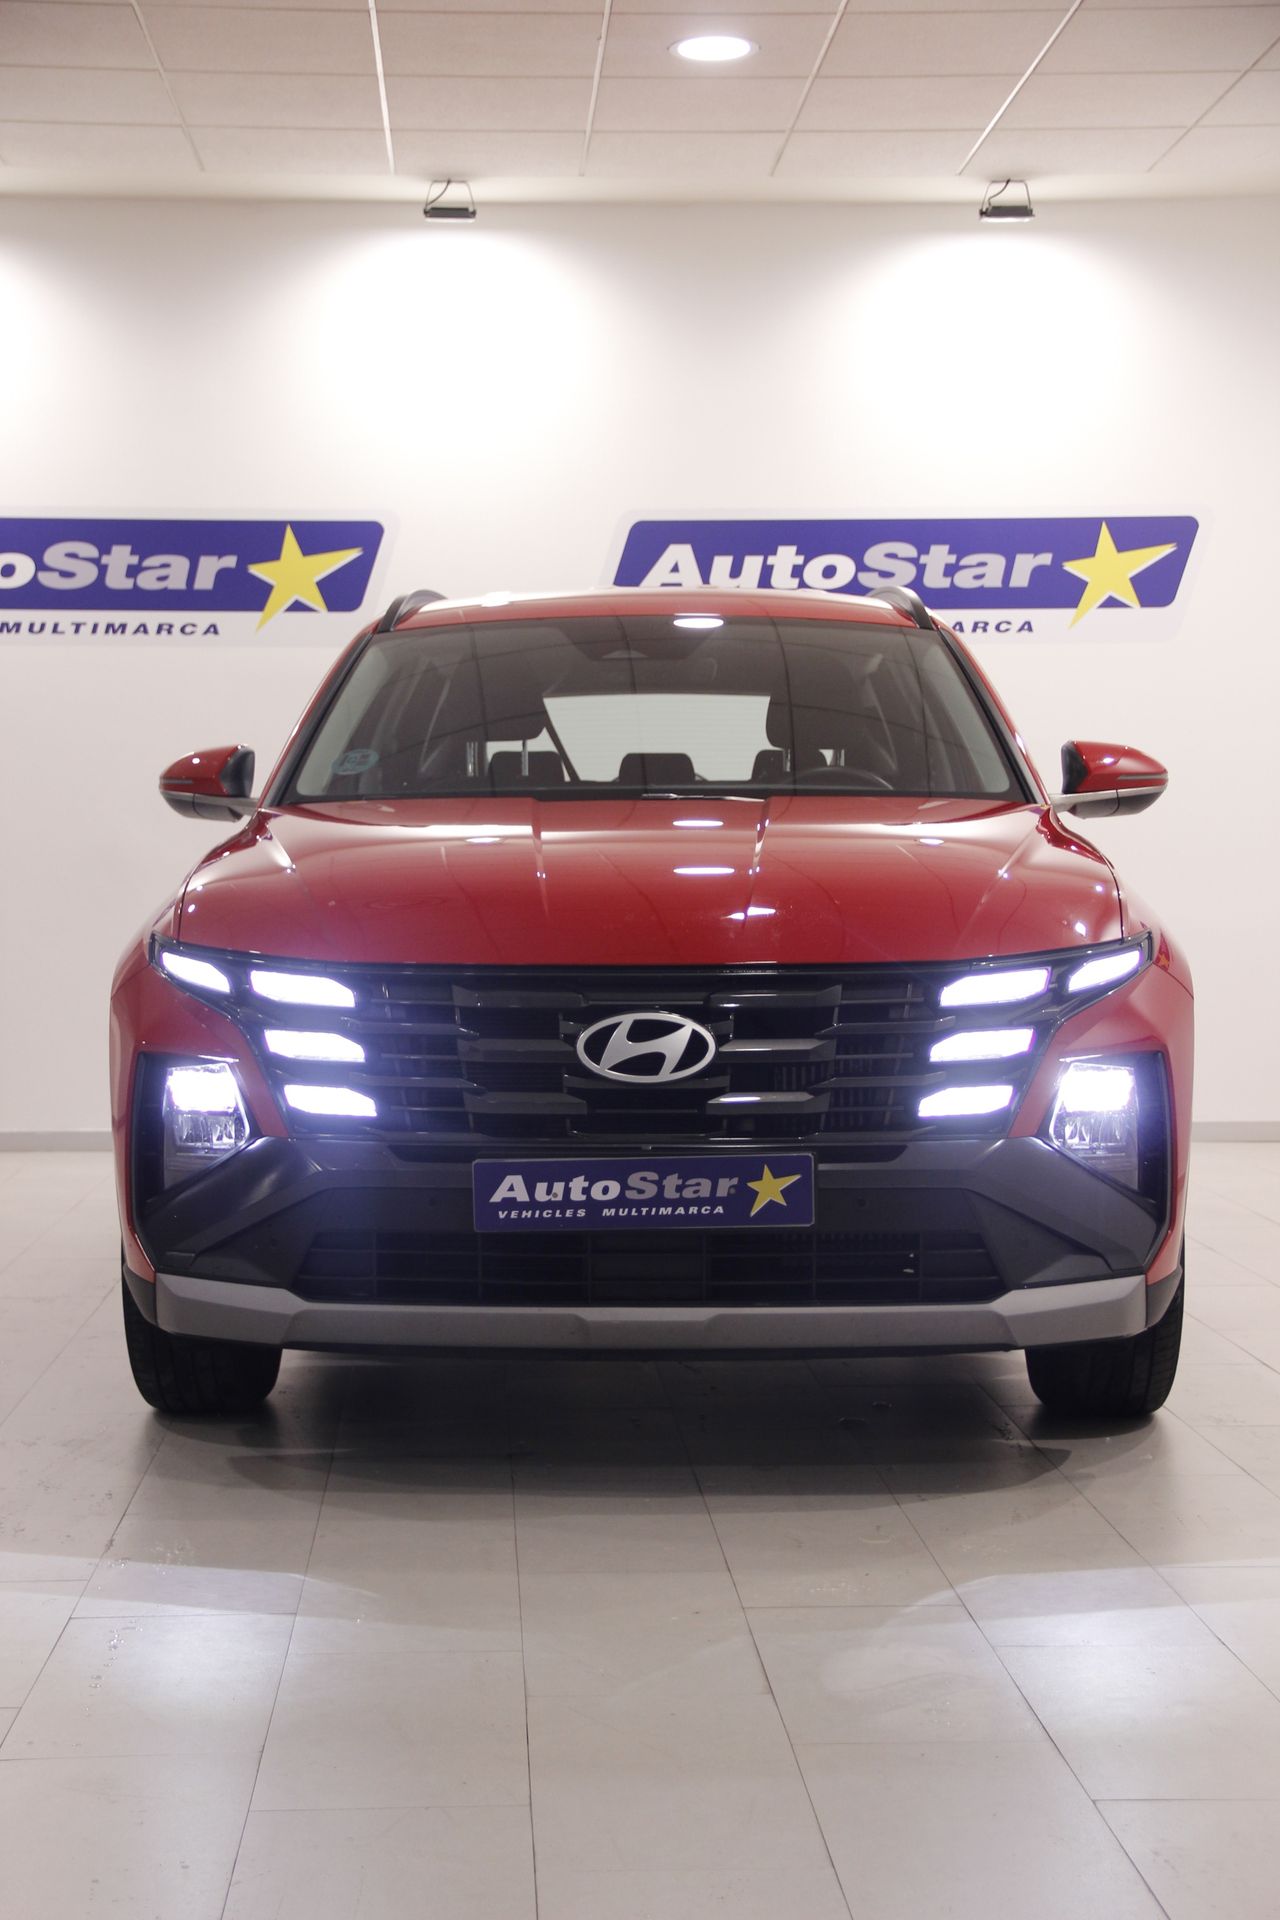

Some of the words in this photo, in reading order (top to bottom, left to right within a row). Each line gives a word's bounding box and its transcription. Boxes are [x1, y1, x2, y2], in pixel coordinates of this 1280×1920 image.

[638, 541, 1053, 590] AutoStar
[0, 621, 220, 636] MULTIMARCA
[489, 1171, 739, 1203] AutoStar
[498, 1208, 587, 1219] VEHICLES
[602, 1205, 725, 1217] MULTIMARCA
